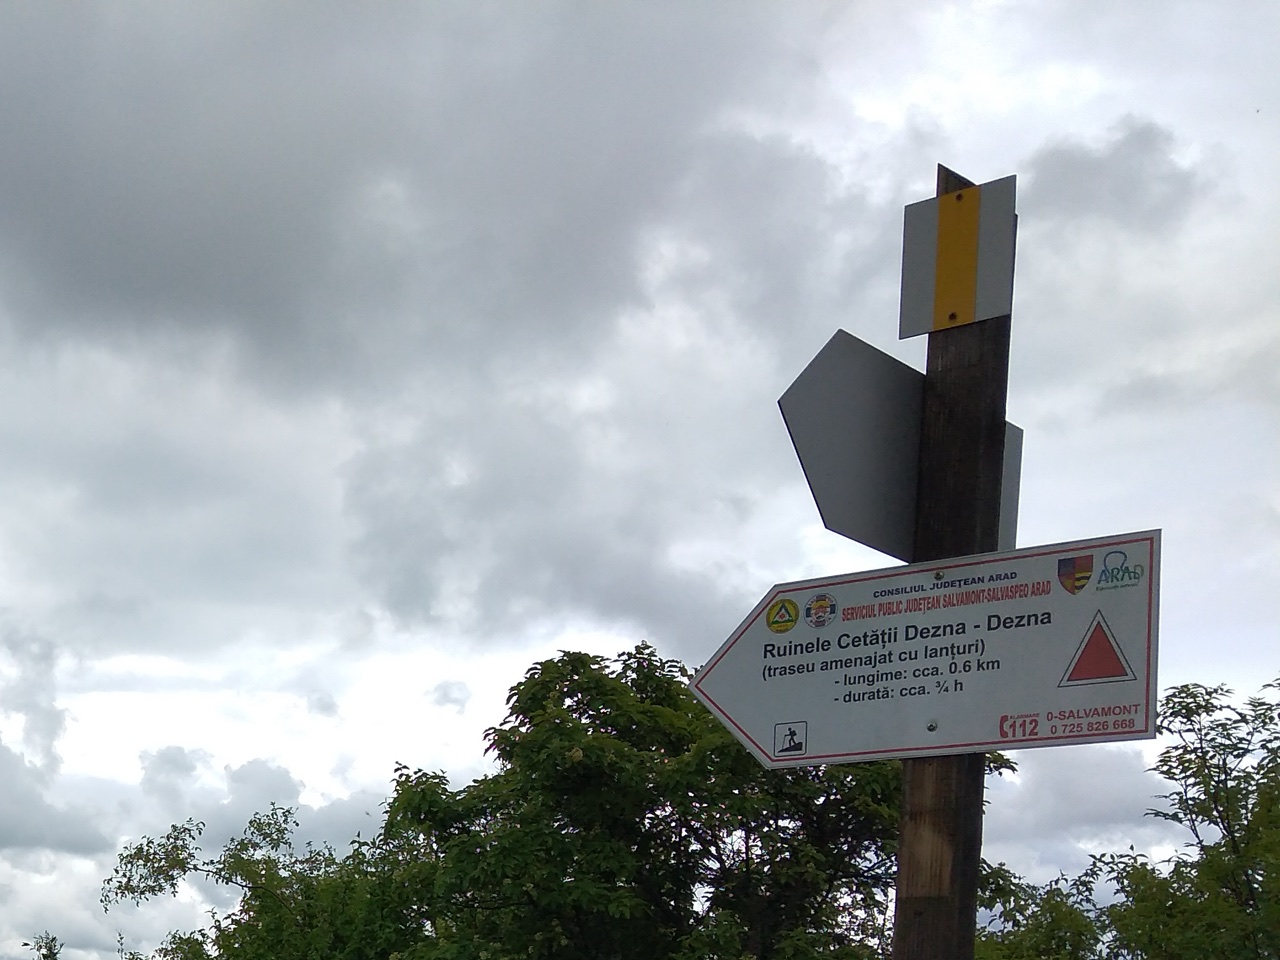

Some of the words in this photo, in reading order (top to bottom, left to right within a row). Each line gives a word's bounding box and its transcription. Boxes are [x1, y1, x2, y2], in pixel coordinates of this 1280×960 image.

[873, 584, 927, 599] CONSILIUL
[987, 571, 1018, 583] ARAD
[842, 603, 877, 622] SERVICIUL
[878, 600, 903, 617] PUBLIC
[942, 583, 1029, 608] SALVAMONT-SALVASPEO
[1030, 580, 1052, 597] ARAD
[763, 637, 832, 659] Ruinele
[837, 626, 898, 649] Cetății
[904, 621, 967, 642] Dezna
[987, 611, 1052, 632] Dezna
[762, 662, 815, 681] (traseu
[820, 650, 893, 671] amenajat
[898, 649, 918, 662] cu
[924, 638, 986, 660] lanțuri)
[843, 669, 907, 686] lungime:
[912, 665, 944, 678] cca.
[948, 660, 971, 675] 0.6
[976, 658, 1001, 672] km
[843, 686, 894, 703] durată:
[899, 685, 931, 697] cca.
[953, 679, 964, 692] h
[1009, 718, 1039, 738] 112
[1050, 724, 1058, 735] 0
[1061, 722, 1083, 734] 725
[1087, 720, 1109, 732] 826
[1112, 718, 1135, 729] 668
